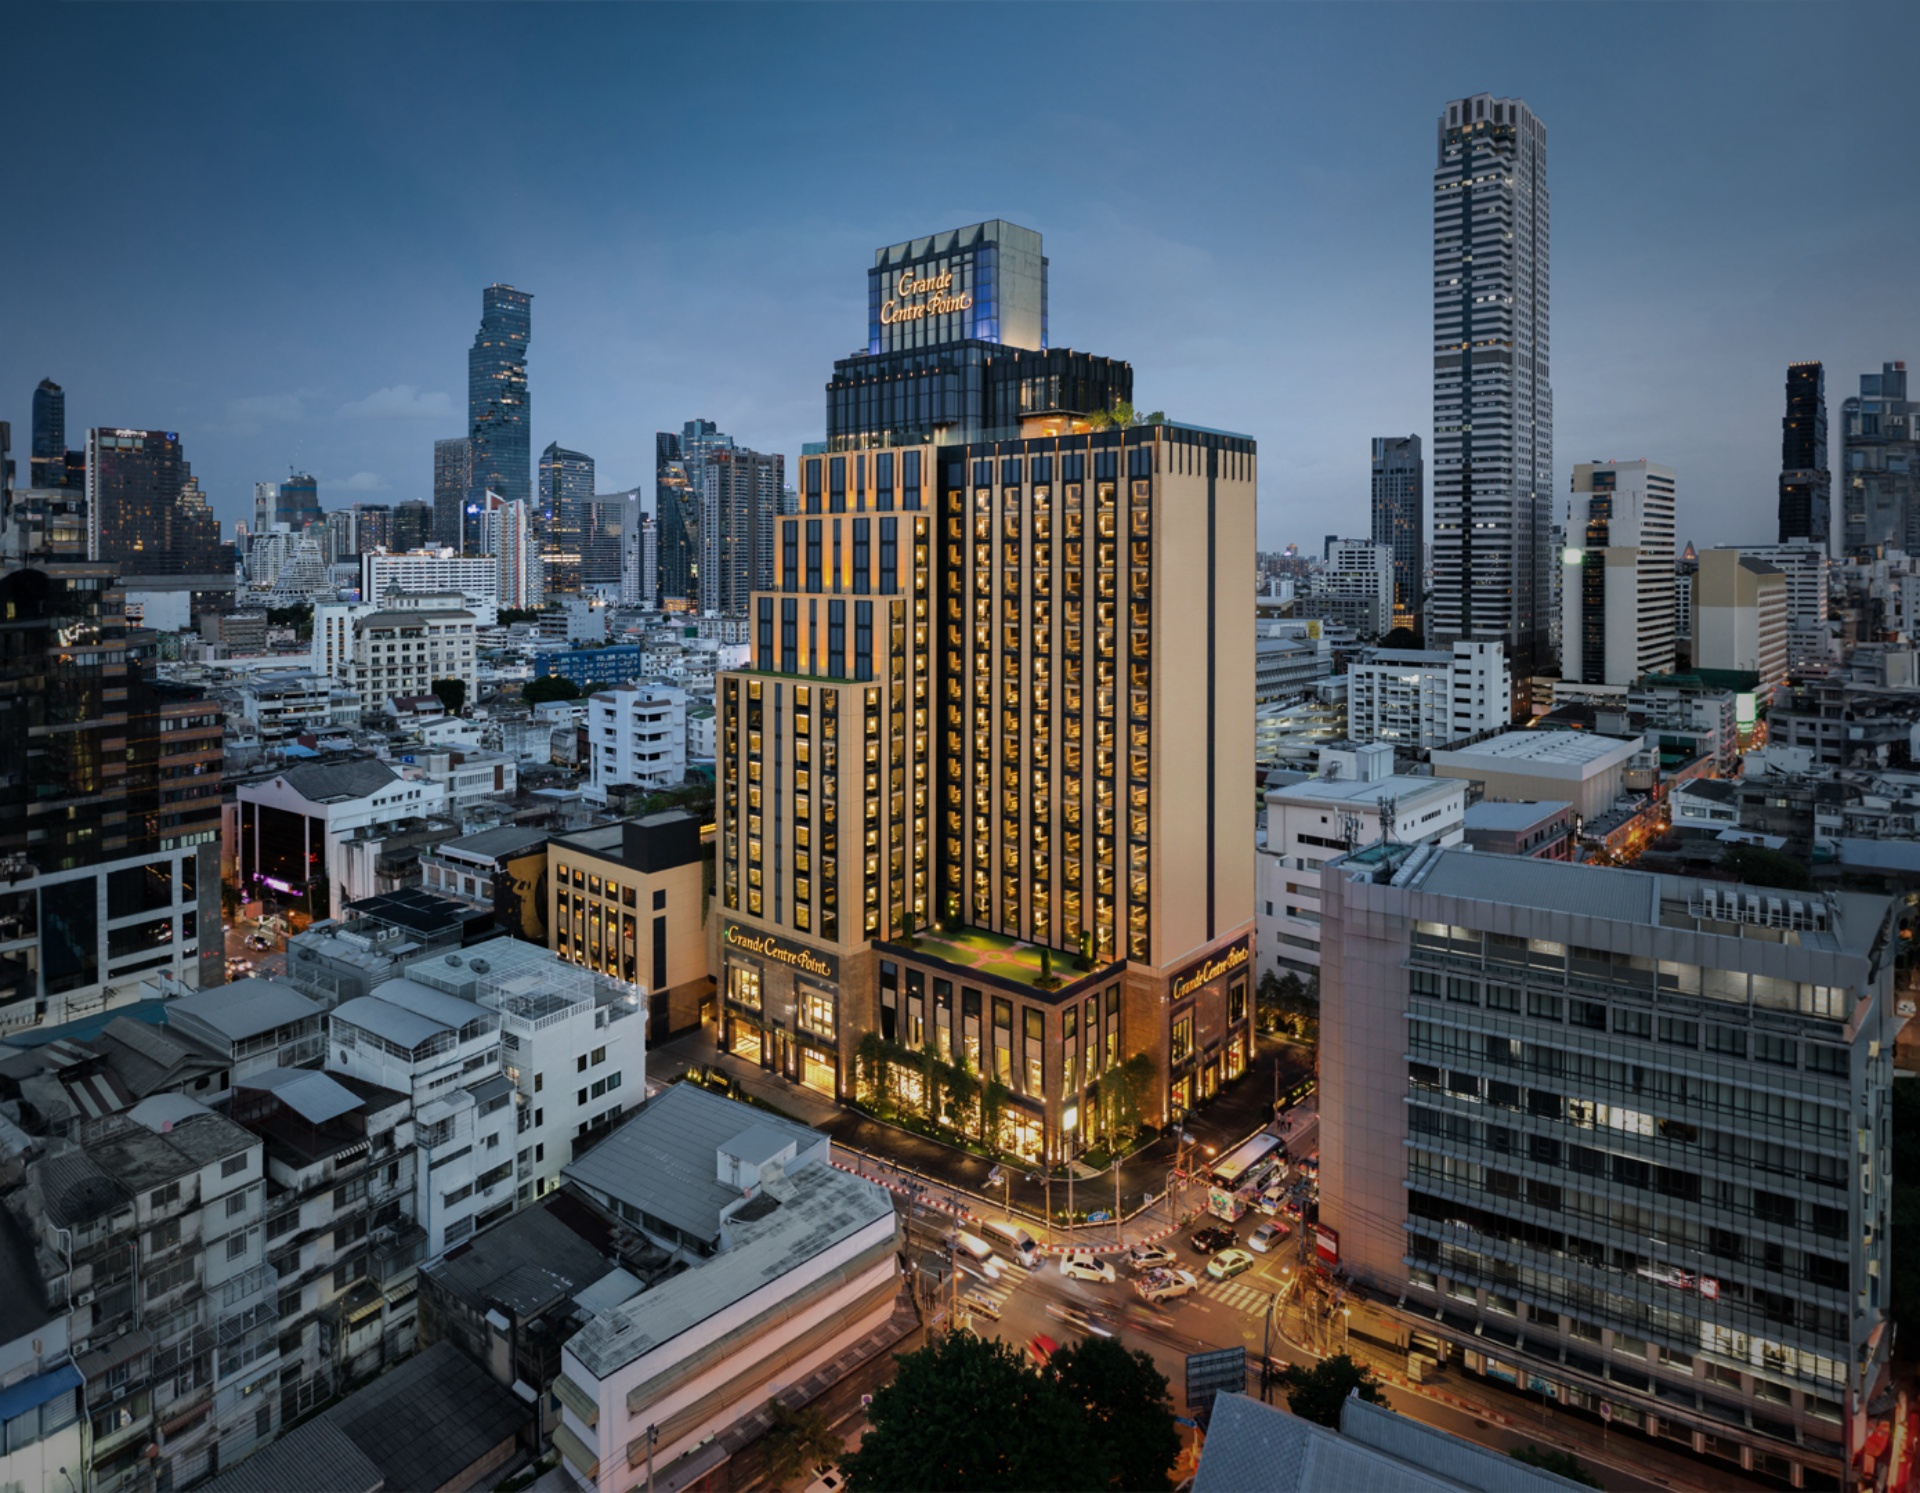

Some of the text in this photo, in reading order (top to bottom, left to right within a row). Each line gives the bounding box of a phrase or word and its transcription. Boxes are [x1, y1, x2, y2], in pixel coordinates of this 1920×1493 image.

[898, 267, 953, 297] Grande
[880, 290, 973, 325] Centre Point
[728, 925, 832, 977] Grande Centre Point
[1173, 970, 1204, 999] Grande
